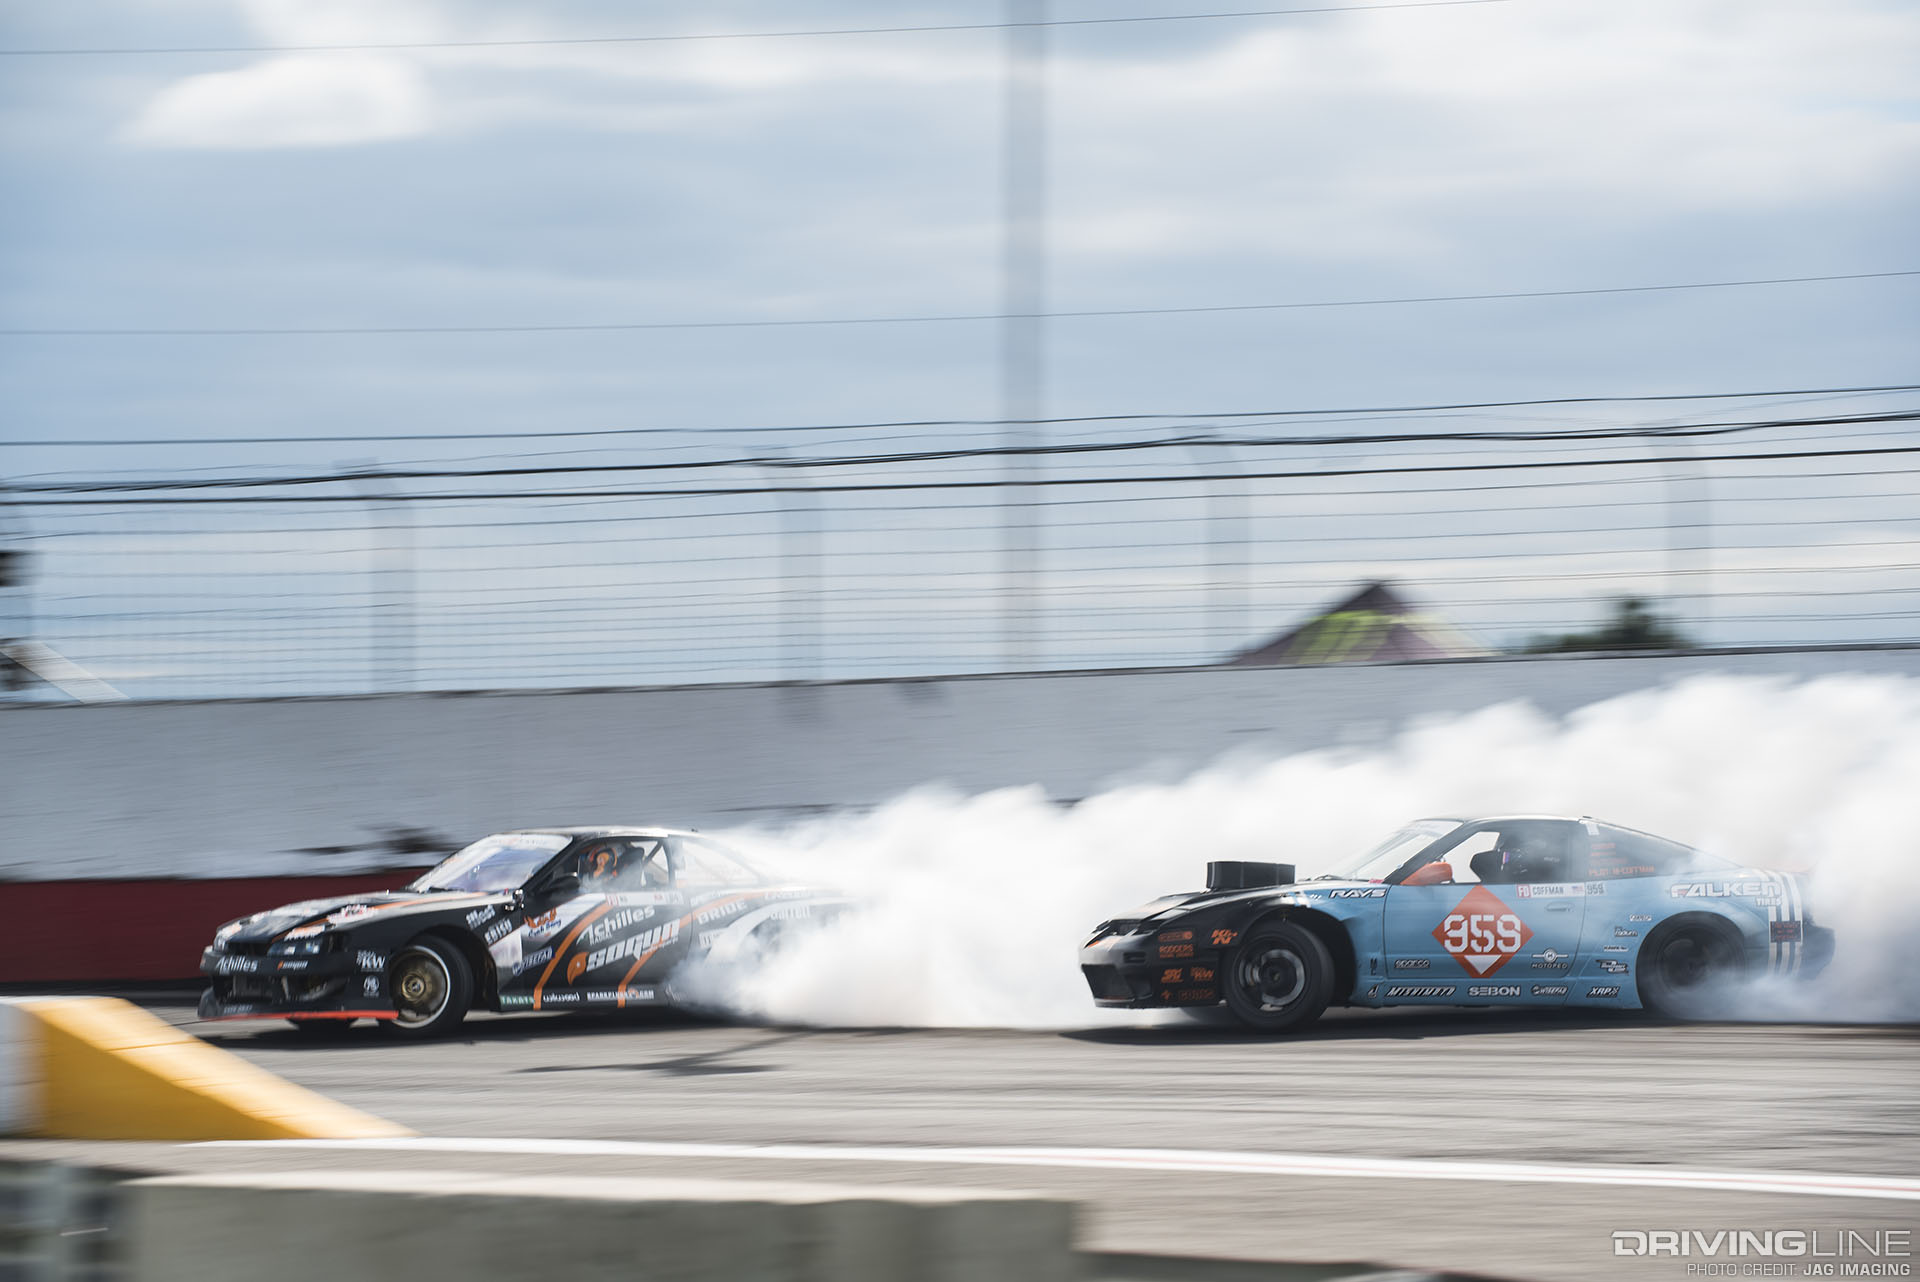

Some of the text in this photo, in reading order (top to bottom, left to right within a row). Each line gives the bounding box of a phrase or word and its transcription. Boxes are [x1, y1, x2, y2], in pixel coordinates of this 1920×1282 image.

[1330, 888, 1387, 898] RAYS
[1533, 886, 1564, 896] COFFMAN
[1671, 882, 1781, 898] FALKEN
[698, 902, 747, 924] BRIDE
[576, 905, 655, 945] Achilles
[1444, 915, 1521, 953] 959
[215, 956, 258, 972] Achilles
[362, 955, 385, 969] KW
[1468, 986, 1520, 996] SEBON
